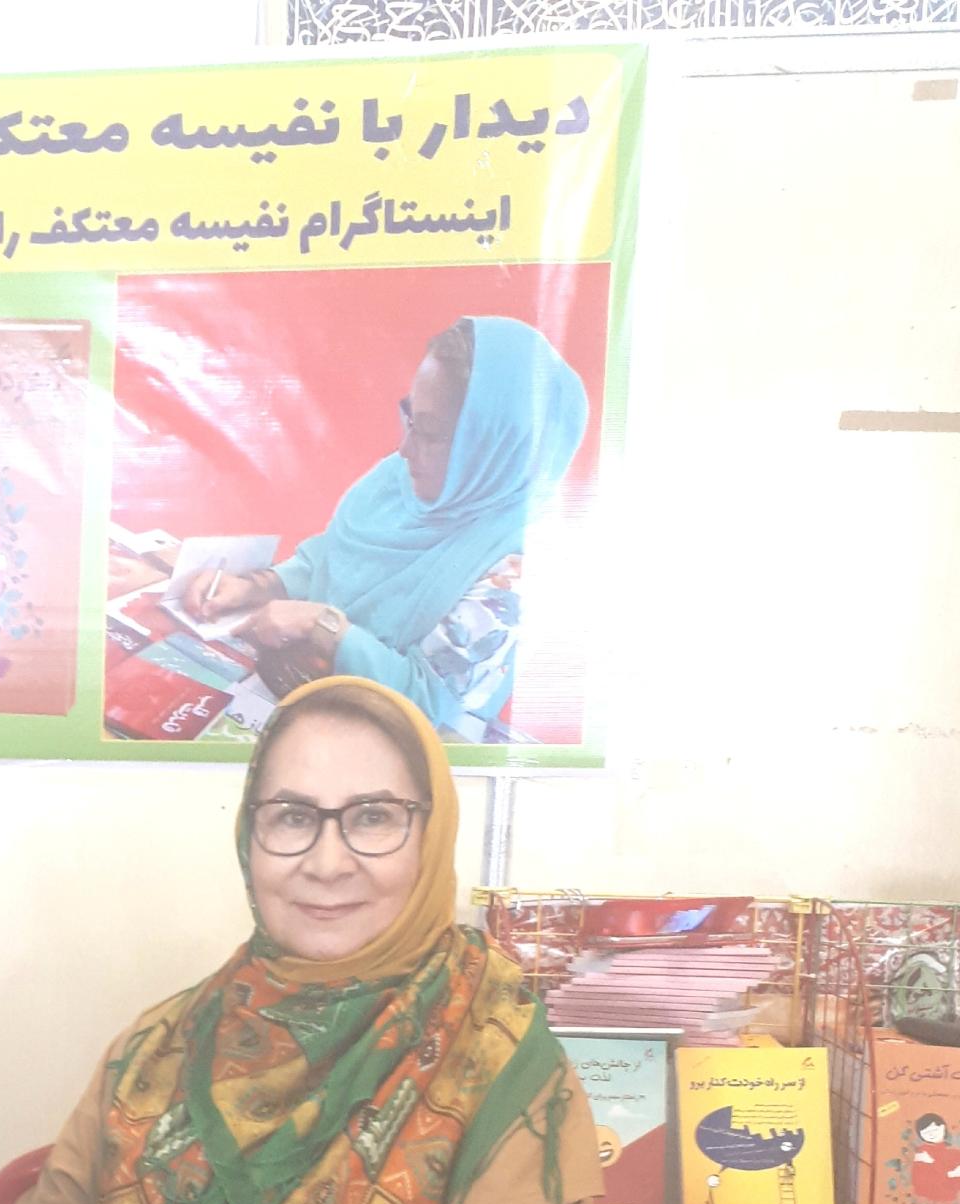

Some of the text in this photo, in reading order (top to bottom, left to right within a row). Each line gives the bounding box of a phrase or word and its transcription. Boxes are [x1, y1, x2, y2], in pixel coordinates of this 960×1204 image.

[151, 96, 341, 164] نفیسه
[362, 98, 403, 162] با
[418, 94, 591, 158] دیدار
[30, 208, 159, 246] معتکف
[170, 203, 289, 252] نفیسه
[300, 191, 512, 253] اینستاگرام
[886, 1064, 909, 1081] کن
